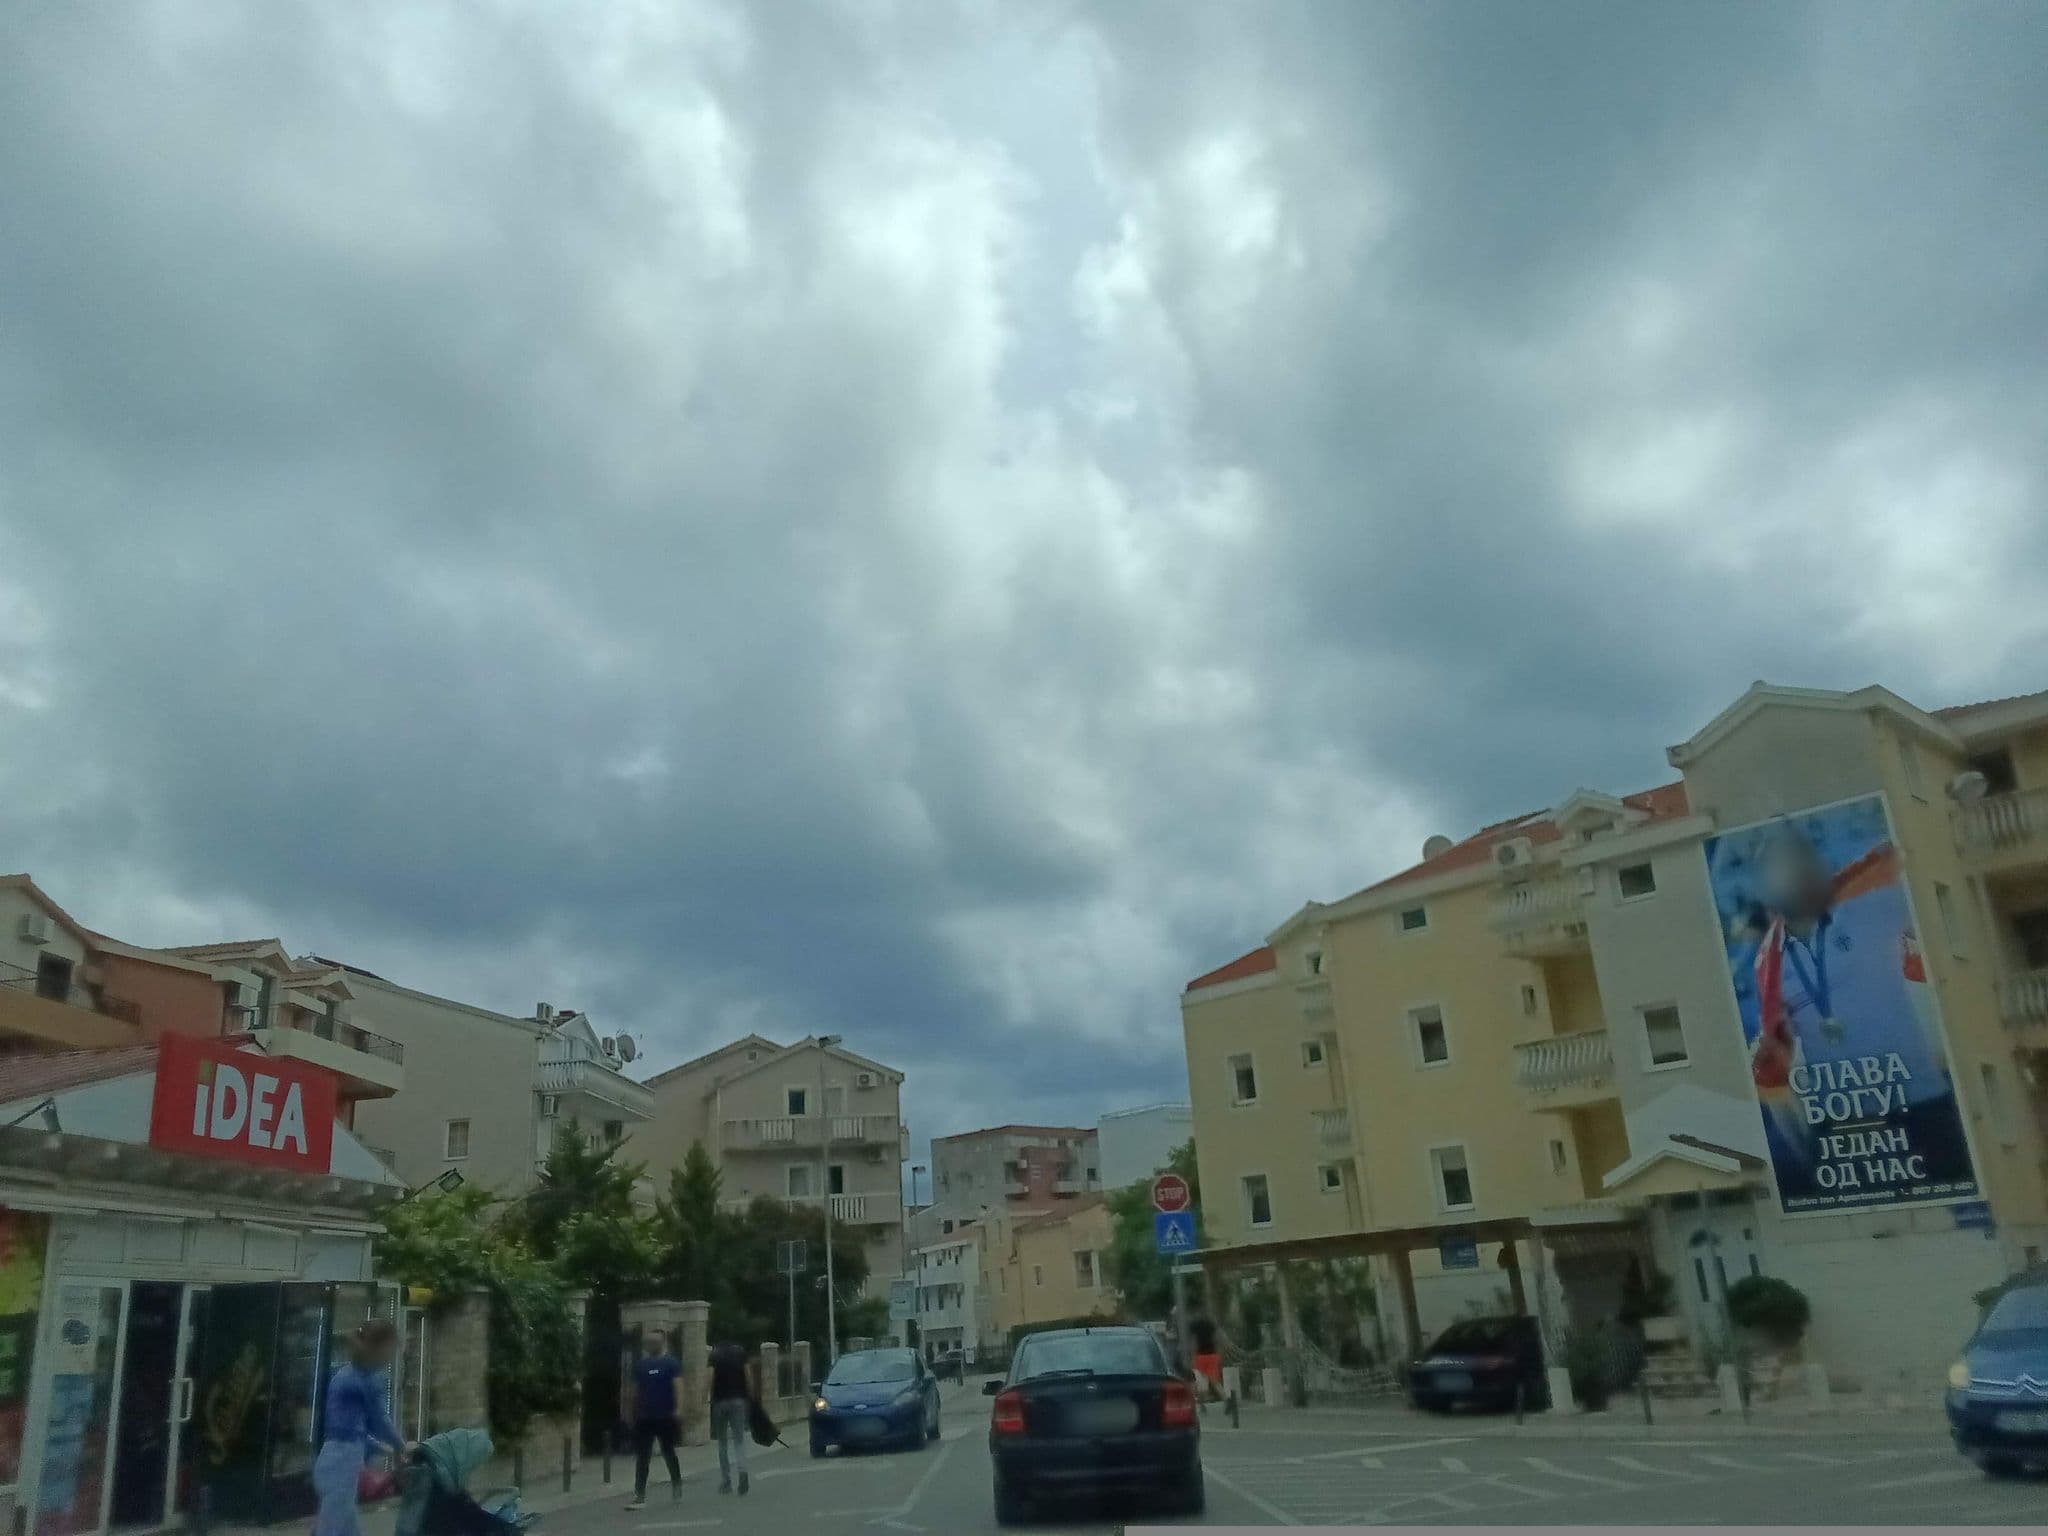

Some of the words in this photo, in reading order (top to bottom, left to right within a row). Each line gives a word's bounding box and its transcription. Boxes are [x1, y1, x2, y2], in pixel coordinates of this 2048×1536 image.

[1789, 1053, 1912, 1094] СЛАВА
[1801, 1084, 1909, 1124] БОГУ!
[1819, 1127, 1909, 1160] ЈЕДАН
[1816, 1162, 1860, 1189] ОД
[1864, 1154, 1926, 1184] НАС
[1157, 1186, 1184, 1202] STOP
